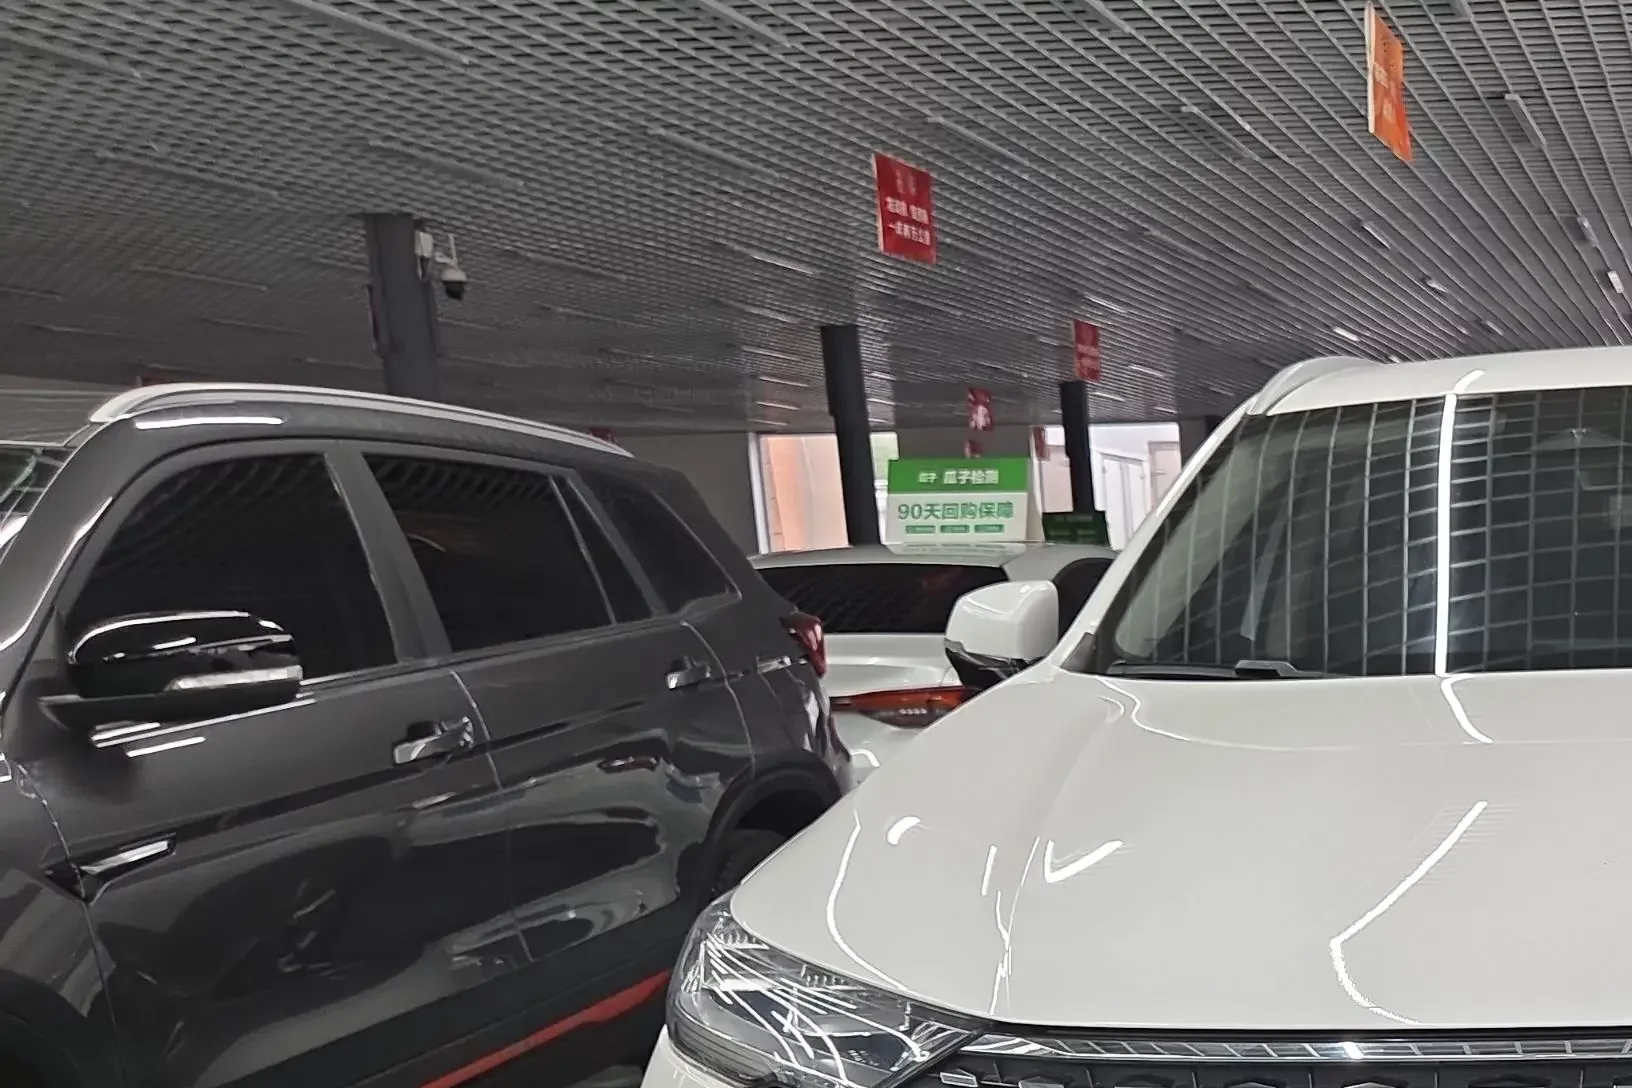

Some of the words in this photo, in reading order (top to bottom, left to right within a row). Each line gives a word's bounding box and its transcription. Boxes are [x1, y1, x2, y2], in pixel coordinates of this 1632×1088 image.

[943, 469, 1000, 485] 瓜子检测
[897, 501, 1014, 520] 90天回购保障
